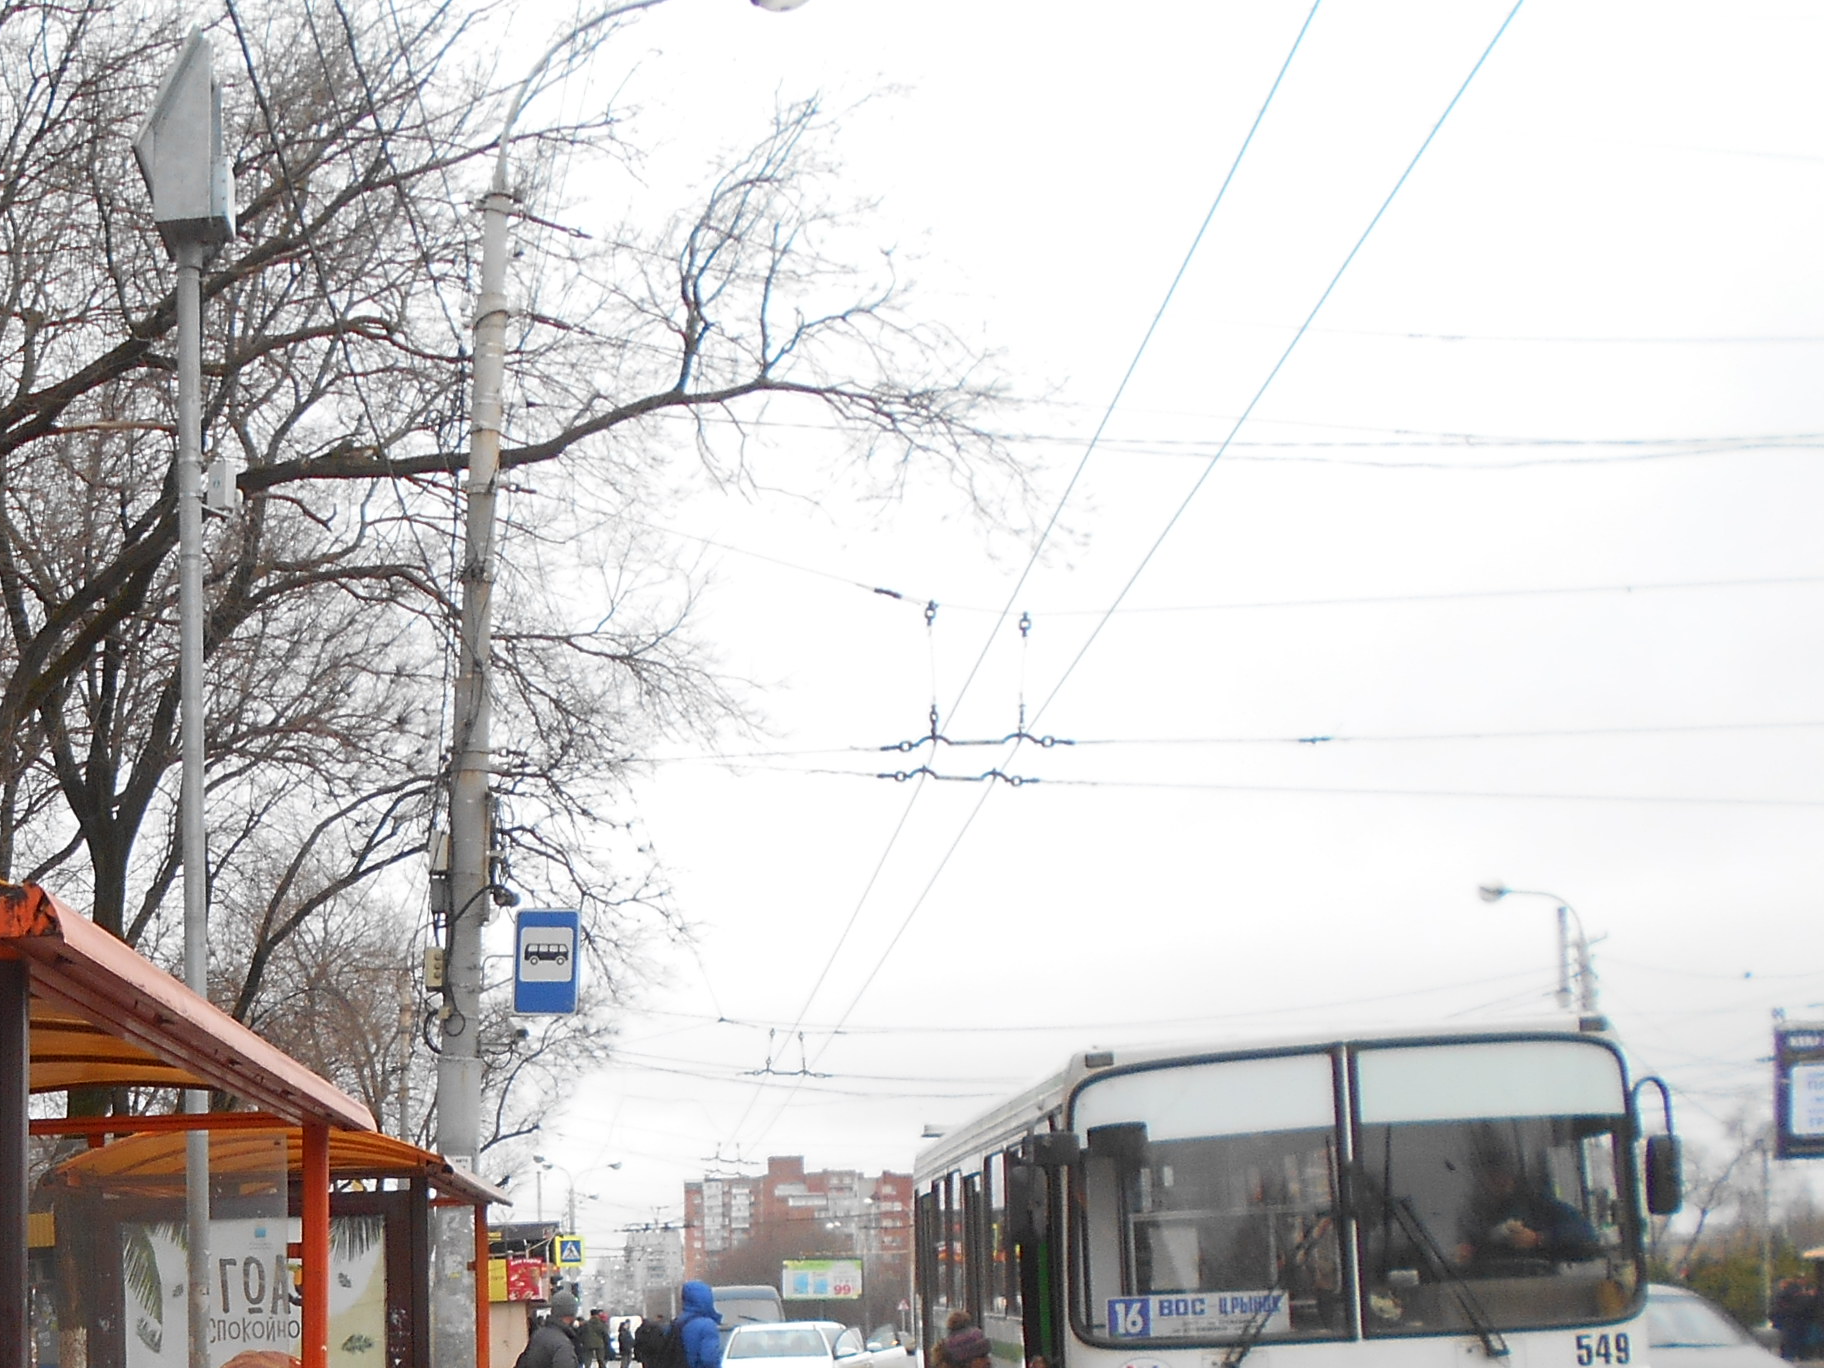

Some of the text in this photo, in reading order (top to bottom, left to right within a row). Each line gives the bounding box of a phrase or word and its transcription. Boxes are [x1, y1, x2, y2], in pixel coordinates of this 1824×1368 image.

[1114, 1302, 1144, 1334] 16
[1159, 1298, 1206, 1316] ВОС
[1575, 1332, 1632, 1366] 549
